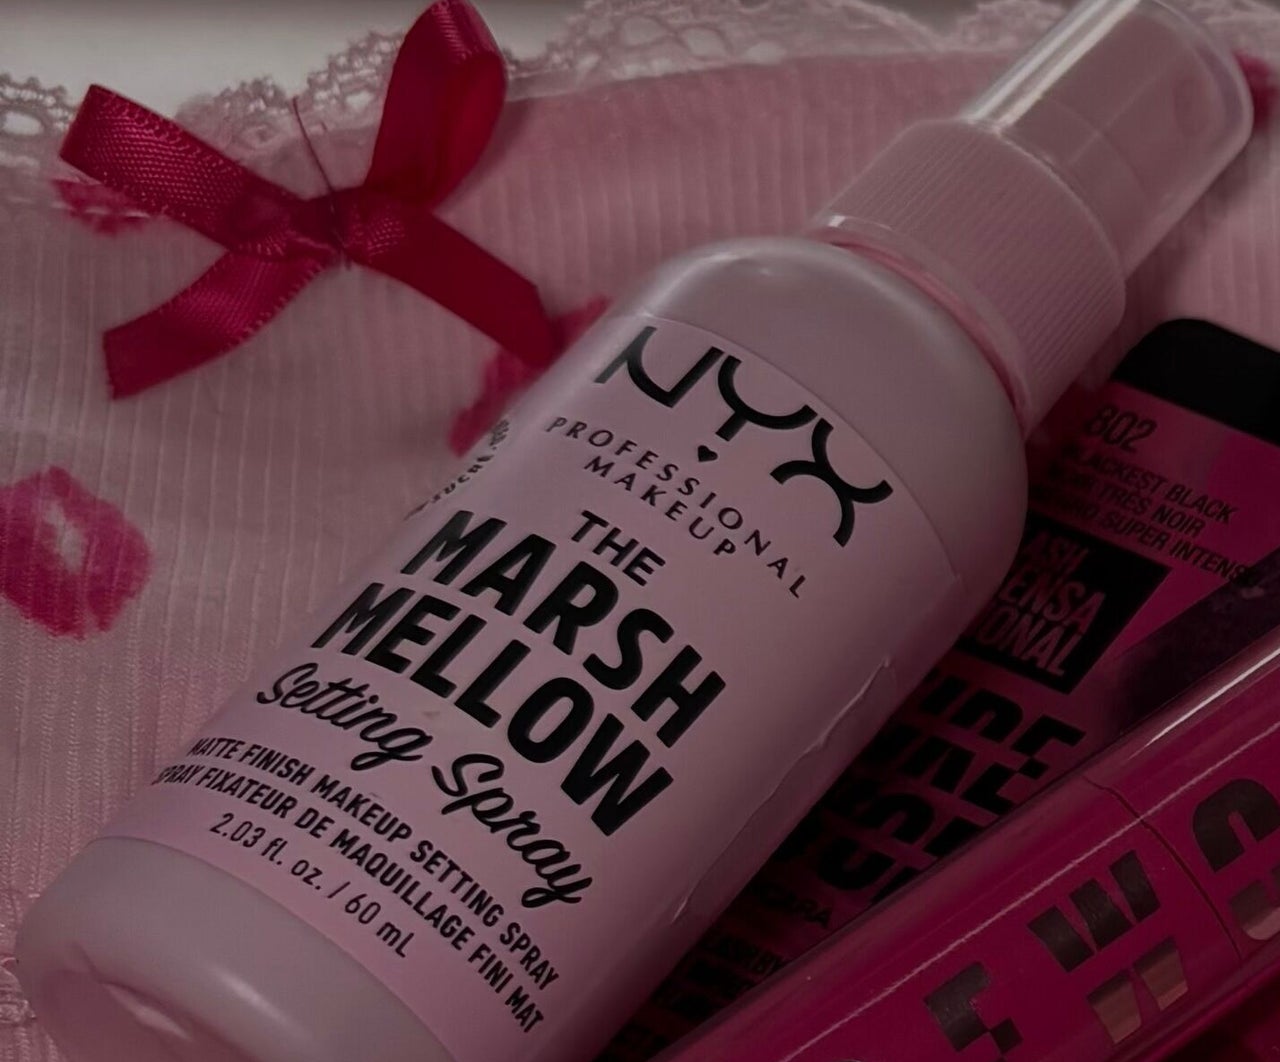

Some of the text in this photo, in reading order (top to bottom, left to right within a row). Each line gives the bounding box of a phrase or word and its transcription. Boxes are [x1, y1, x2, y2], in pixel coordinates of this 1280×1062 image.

[594, 326, 894, 547] NYX
[1086, 402, 1157, 454] 802
[546, 416, 806, 598] PROFESSIONAL
[569, 510, 667, 587] THE
[584, 455, 736, 556] MAKEUP
[1100, 510, 1170, 551] SUPER
[1150, 503, 1207, 539] NOIR
[1165, 484, 1238, 524] BLACK
[400, 509, 726, 748] MARSH
[976, 604, 1084, 678] ONAL
[998, 563, 1106, 638] ENSA
[310, 582, 674, 836] MELLOW
[256, 662, 433, 771] Setting
[431, 752, 593, 909] Spray
[187, 735, 559, 992] MATTE FINISH MAKEUP SETTING SPRAY
[196, 766, 301, 820] FIXATEUR
[294, 805, 326, 839] DE
[328, 825, 475, 952] MAQUILLAGE
[467, 941, 506, 994] FINI
[504, 987, 544, 1034] MAT
[209, 811, 409, 959] 2.03 fl. oz. / 60 mL
